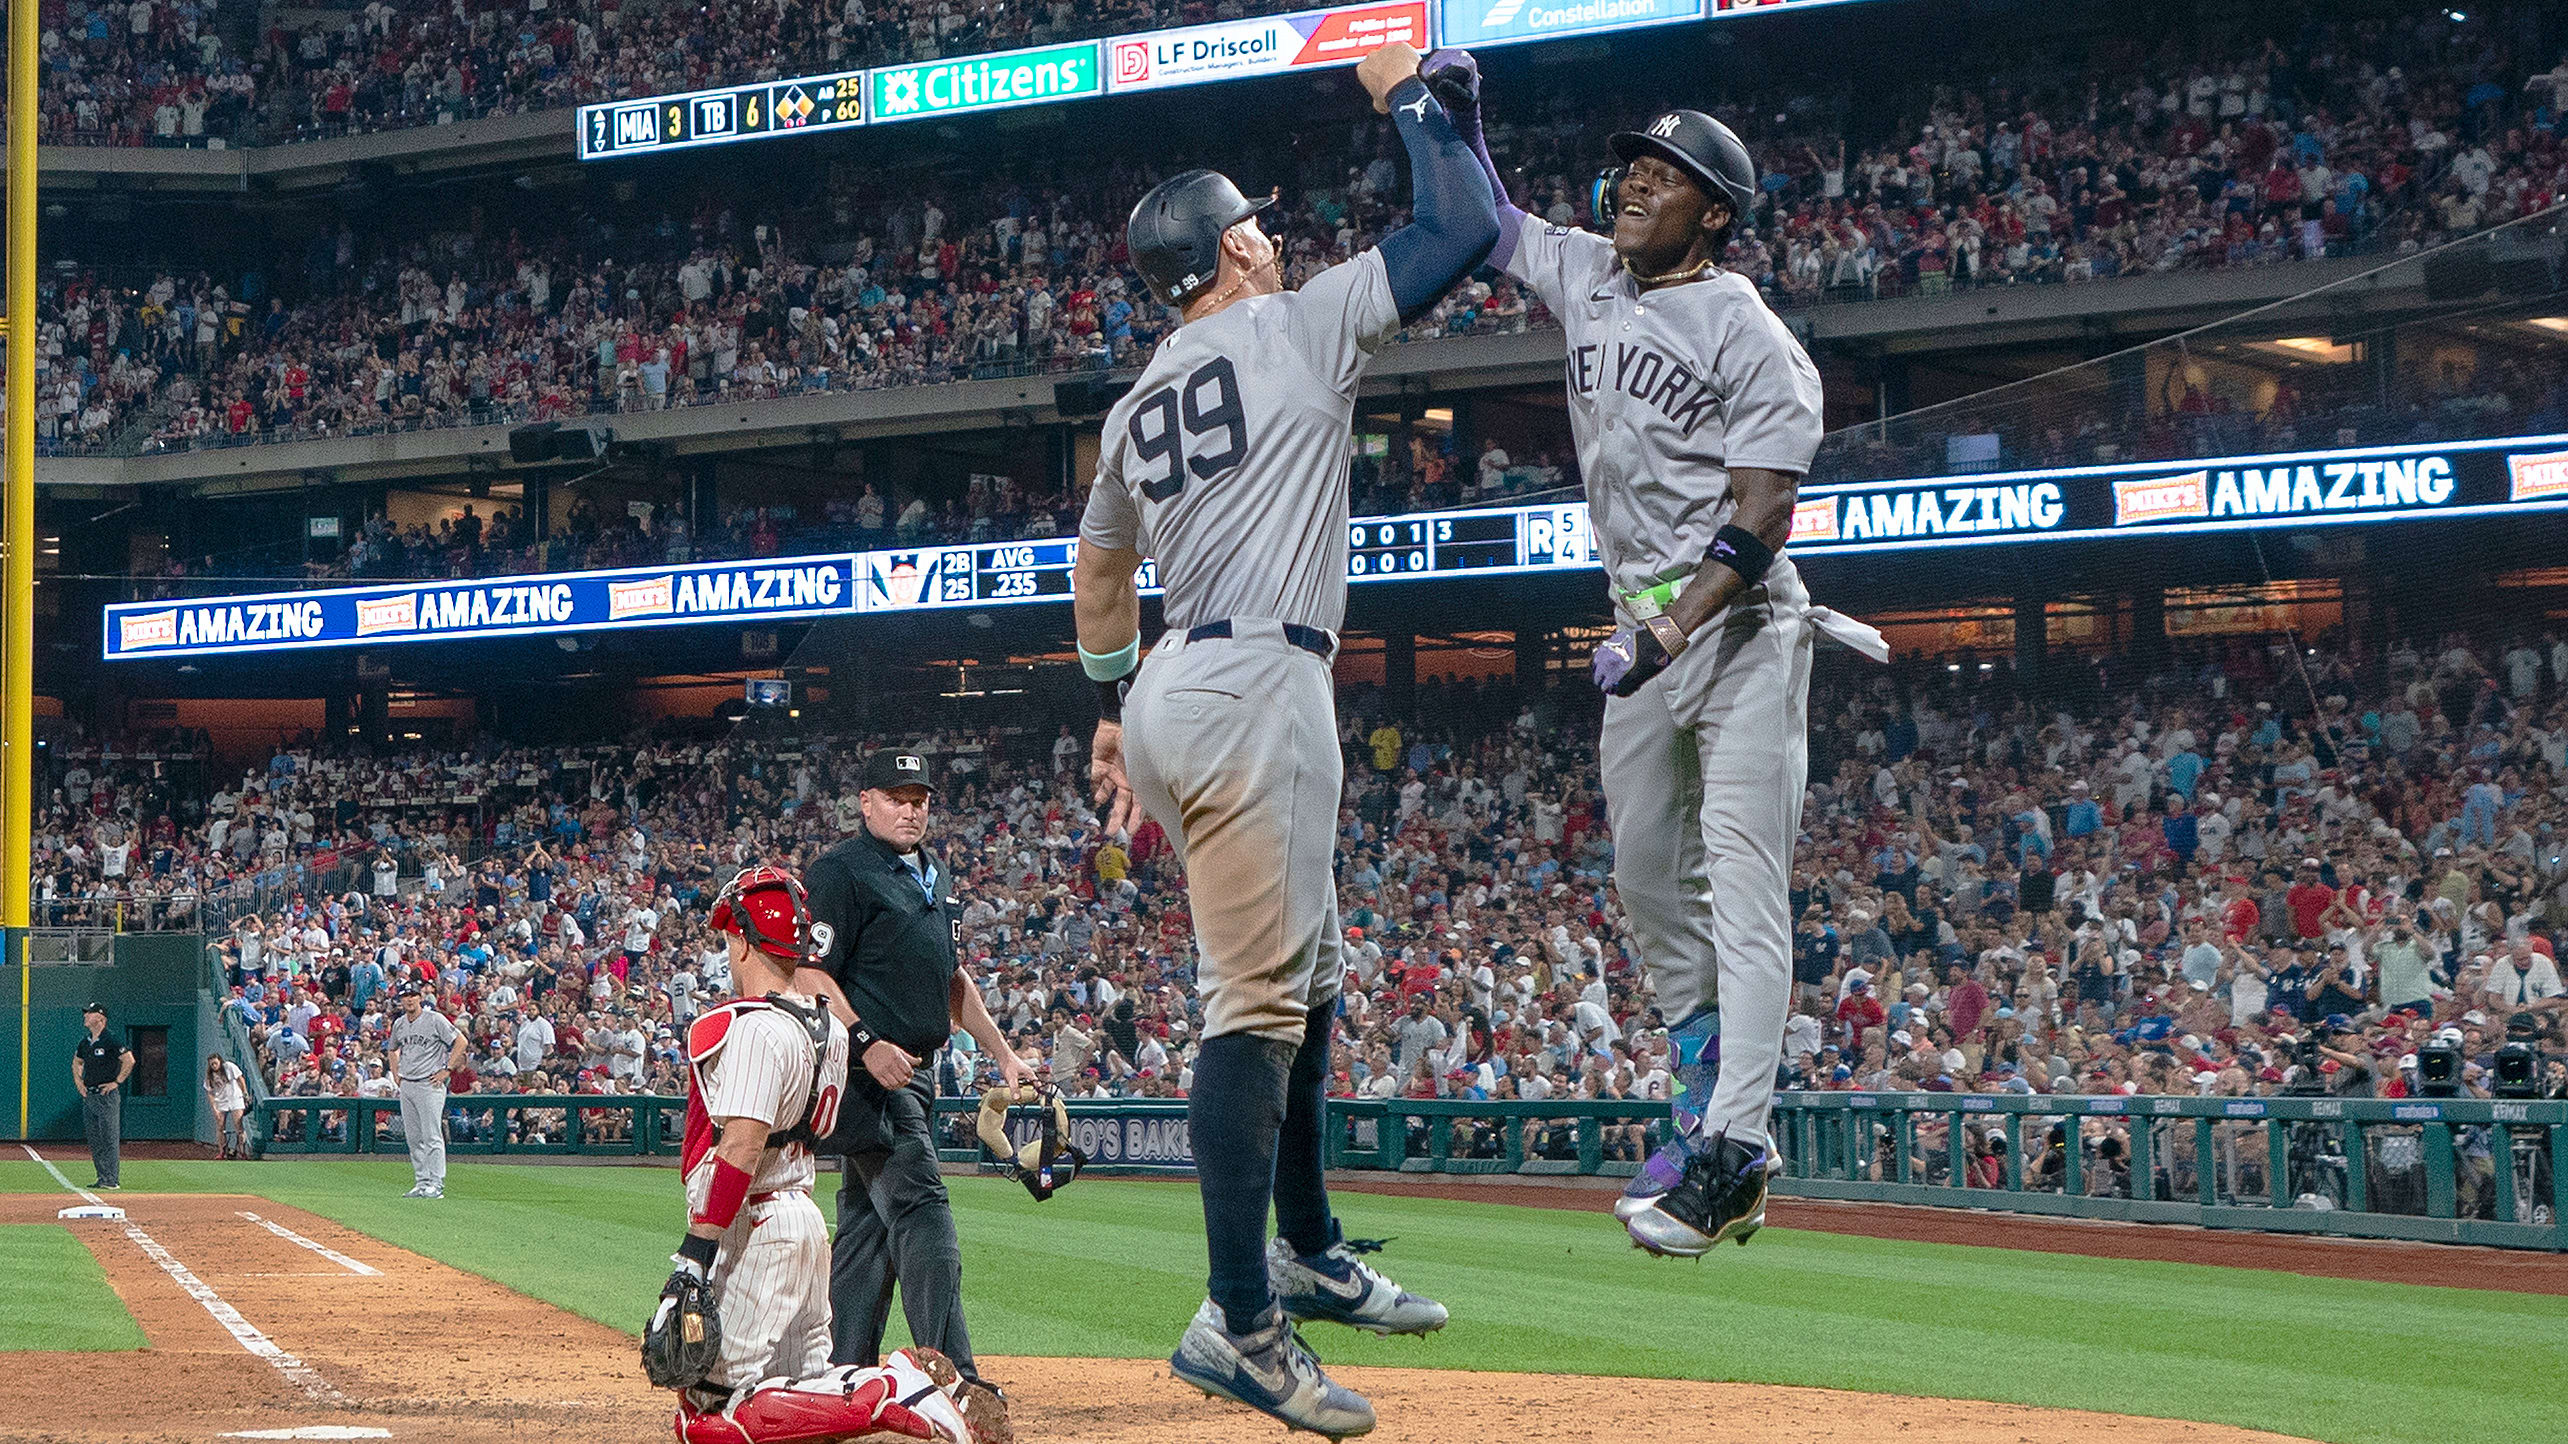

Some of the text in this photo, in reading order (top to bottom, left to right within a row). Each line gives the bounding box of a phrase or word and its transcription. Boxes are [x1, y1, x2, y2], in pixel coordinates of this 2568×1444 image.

[1528, 0, 1655, 28] Constellation
[1158, 29, 1277, 65] LF Driscoll
[924, 61, 1079, 107] Citizens
[1159, 65, 1205, 76] Construction
[818, 79, 859, 101] AB 25
[619, 110, 655, 143] MIA
[668, 106, 682, 137] 3
[701, 101, 726, 133] TB
[746, 96, 759, 127] 6
[822, 100, 860, 122] P 60
[1182, 273, 1199, 290] 99
[1567, 342, 1725, 435] NE YORK
[1129, 355, 1248, 504] 99
[2212, 457, 2455, 517] AMAZING
[2522, 462, 2568, 488] MIK
[1563, 512, 1574, 533] 5
[1842, 482, 2065, 539] AMAZING
[1351, 521, 1452, 547] 0 0 1 3
[1529, 518, 1553, 555] R
[944, 553, 970, 573] 2B
[991, 544, 1079, 569] AVG H
[1351, 550, 1424, 575] 0 0 0
[1563, 540, 1575, 560] 4
[675, 566, 841, 613] AMAZING
[944, 577, 970, 600] 25
[991, 572, 1037, 597] .235
[419, 584, 574, 630] AMAZING
[179, 601, 324, 645] AMAZING
[1126, 1119, 1194, 1161] BAKE
